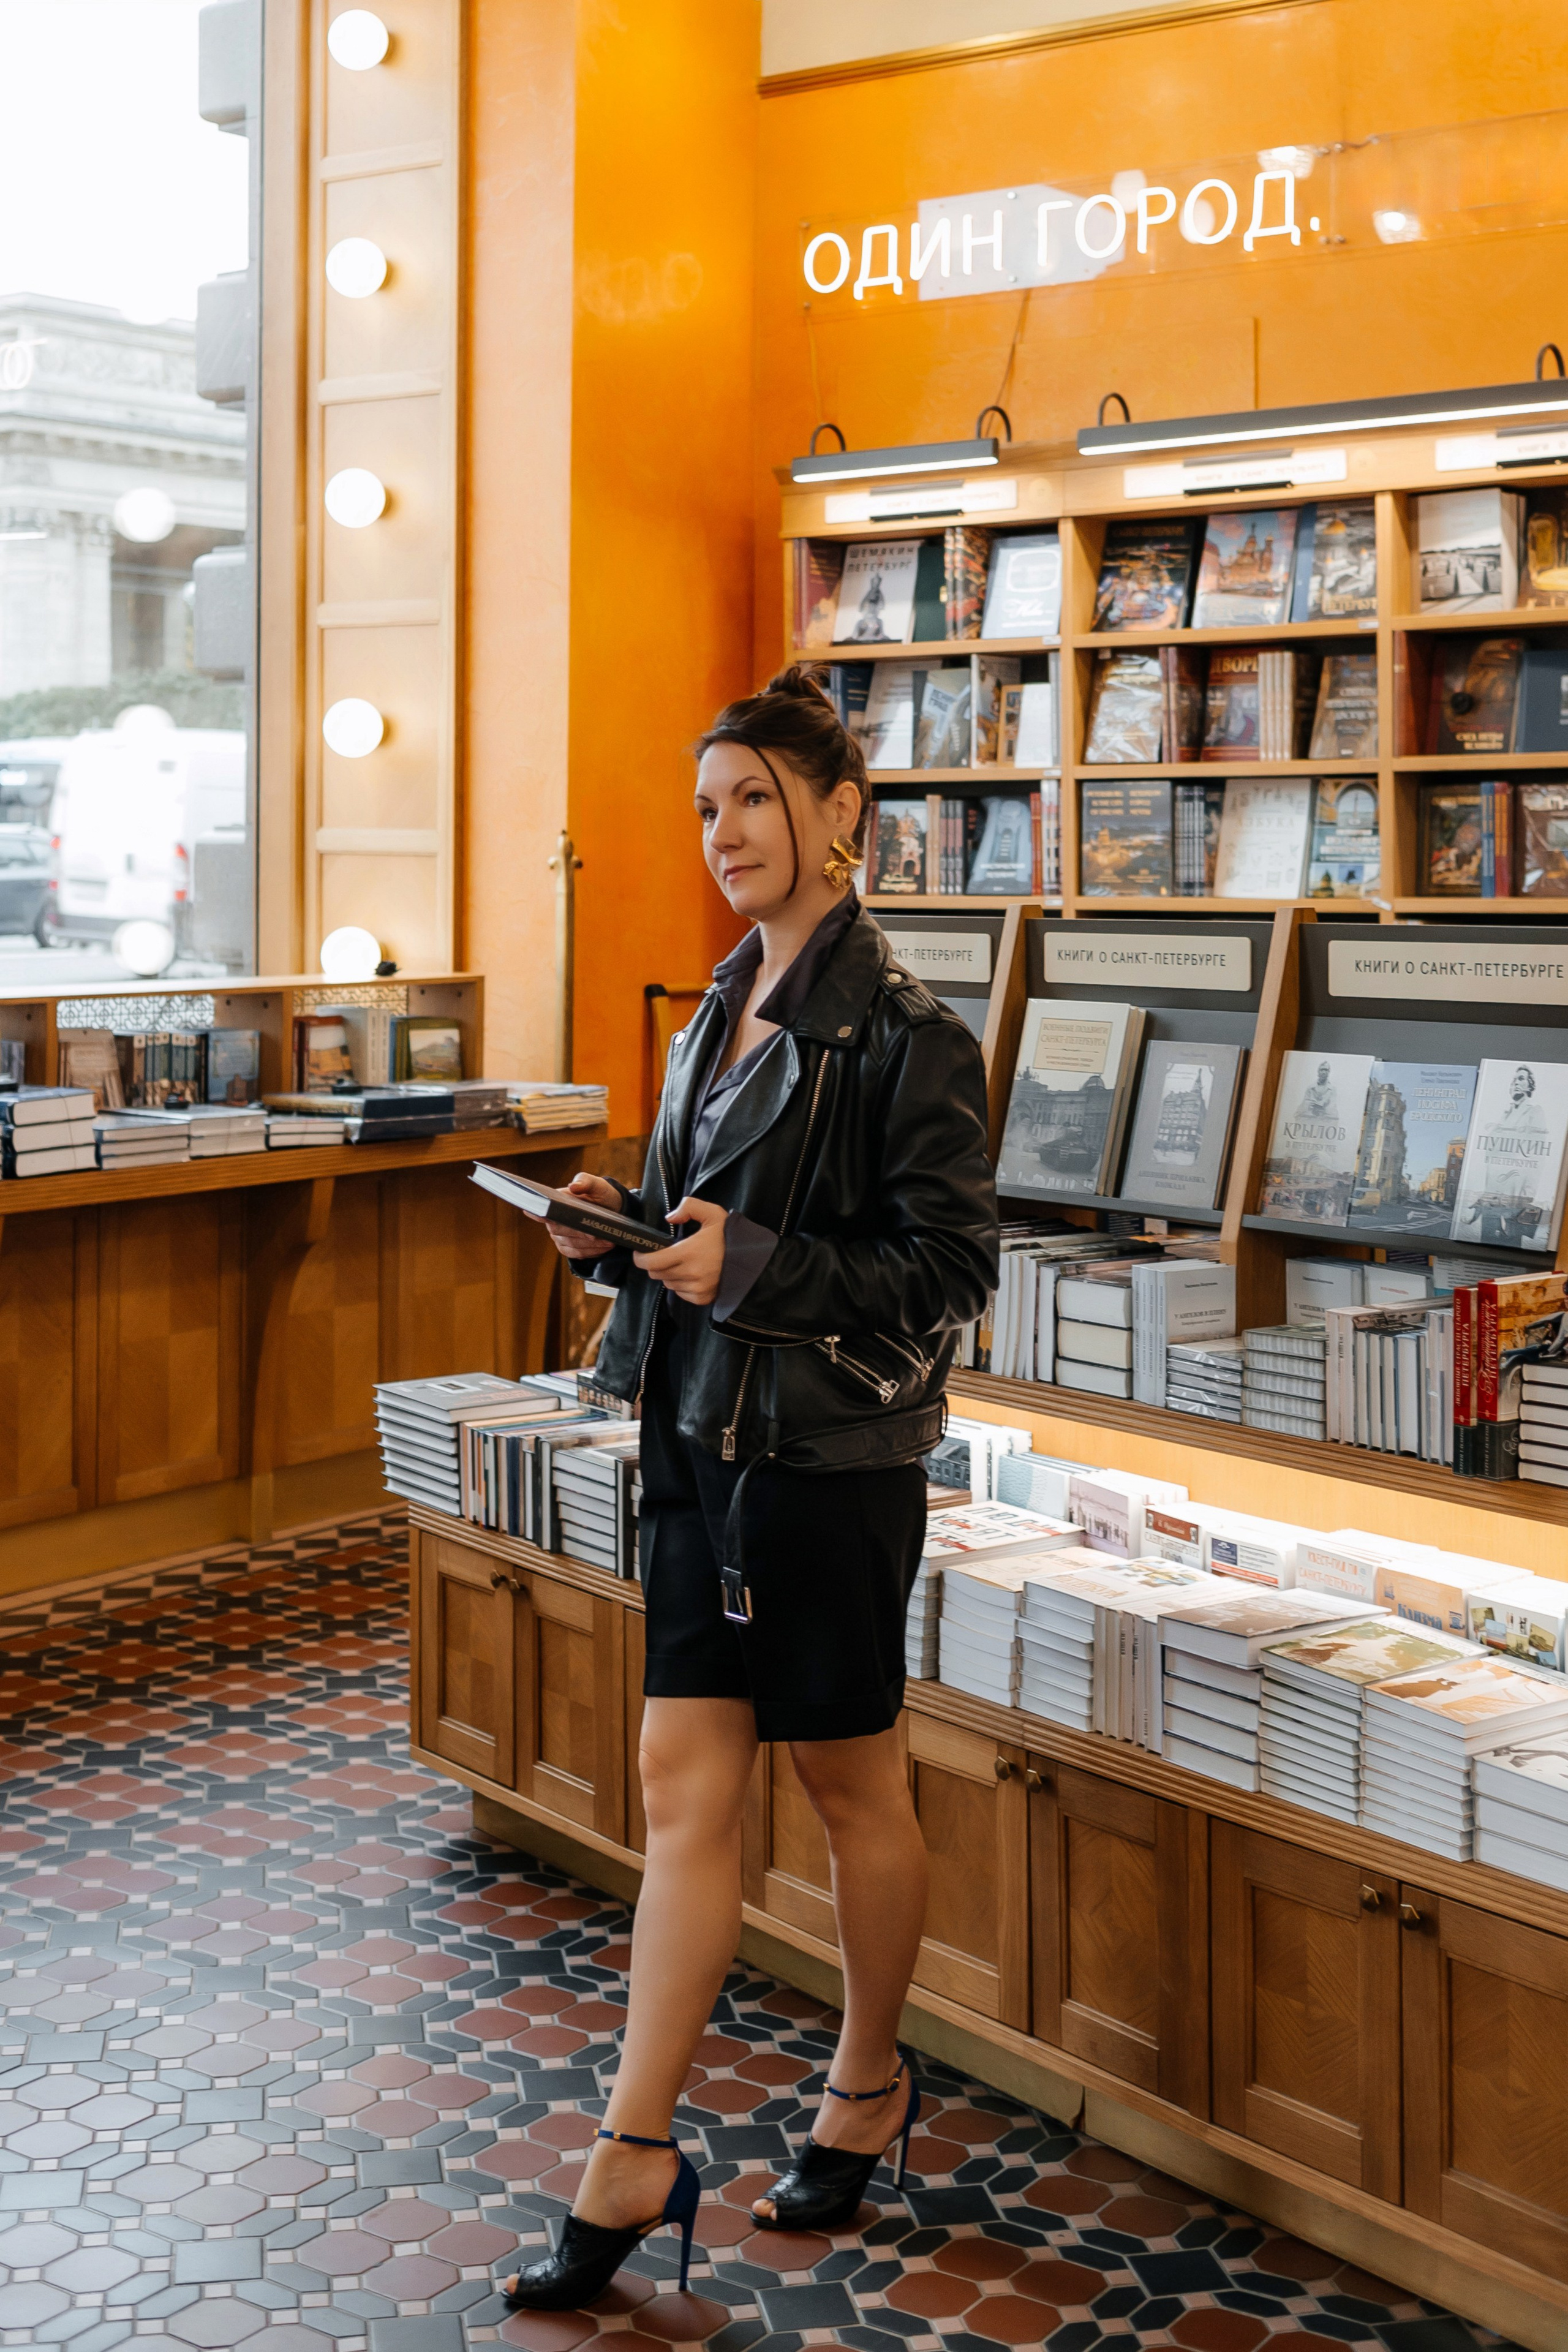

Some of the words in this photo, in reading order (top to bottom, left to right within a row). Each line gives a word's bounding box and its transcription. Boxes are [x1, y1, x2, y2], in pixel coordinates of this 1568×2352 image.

[803, 209, 1004, 301] ОДИН
[1037, 168, 1321, 266] ГОРОД.
[892, 948, 973, 962] НКТ-ПЕТЕРБУРГЕ
[1057, 949, 1093, 962] КНИГИ
[1099, 951, 1107, 963] О
[1111, 951, 1226, 967] САНКТ-ПЕТЕРБУРГЕ
[1355, 959, 1400, 974] КНИГИ
[1405, 961, 1414, 974] О
[1420, 962, 1564, 979] САНКТ-ПЕТЕРБУРГЕ
[1411, 1087, 1466, 1099] ЛЕНИНГРАД
[1409, 1110, 1463, 1123] БРОДСКОГО
[1283, 1122, 1346, 1140] КРЫЛОВ
[1476, 1135, 1552, 1158] ПУШКИН
[963, 1506, 1057, 1532] ЛЮДИ
